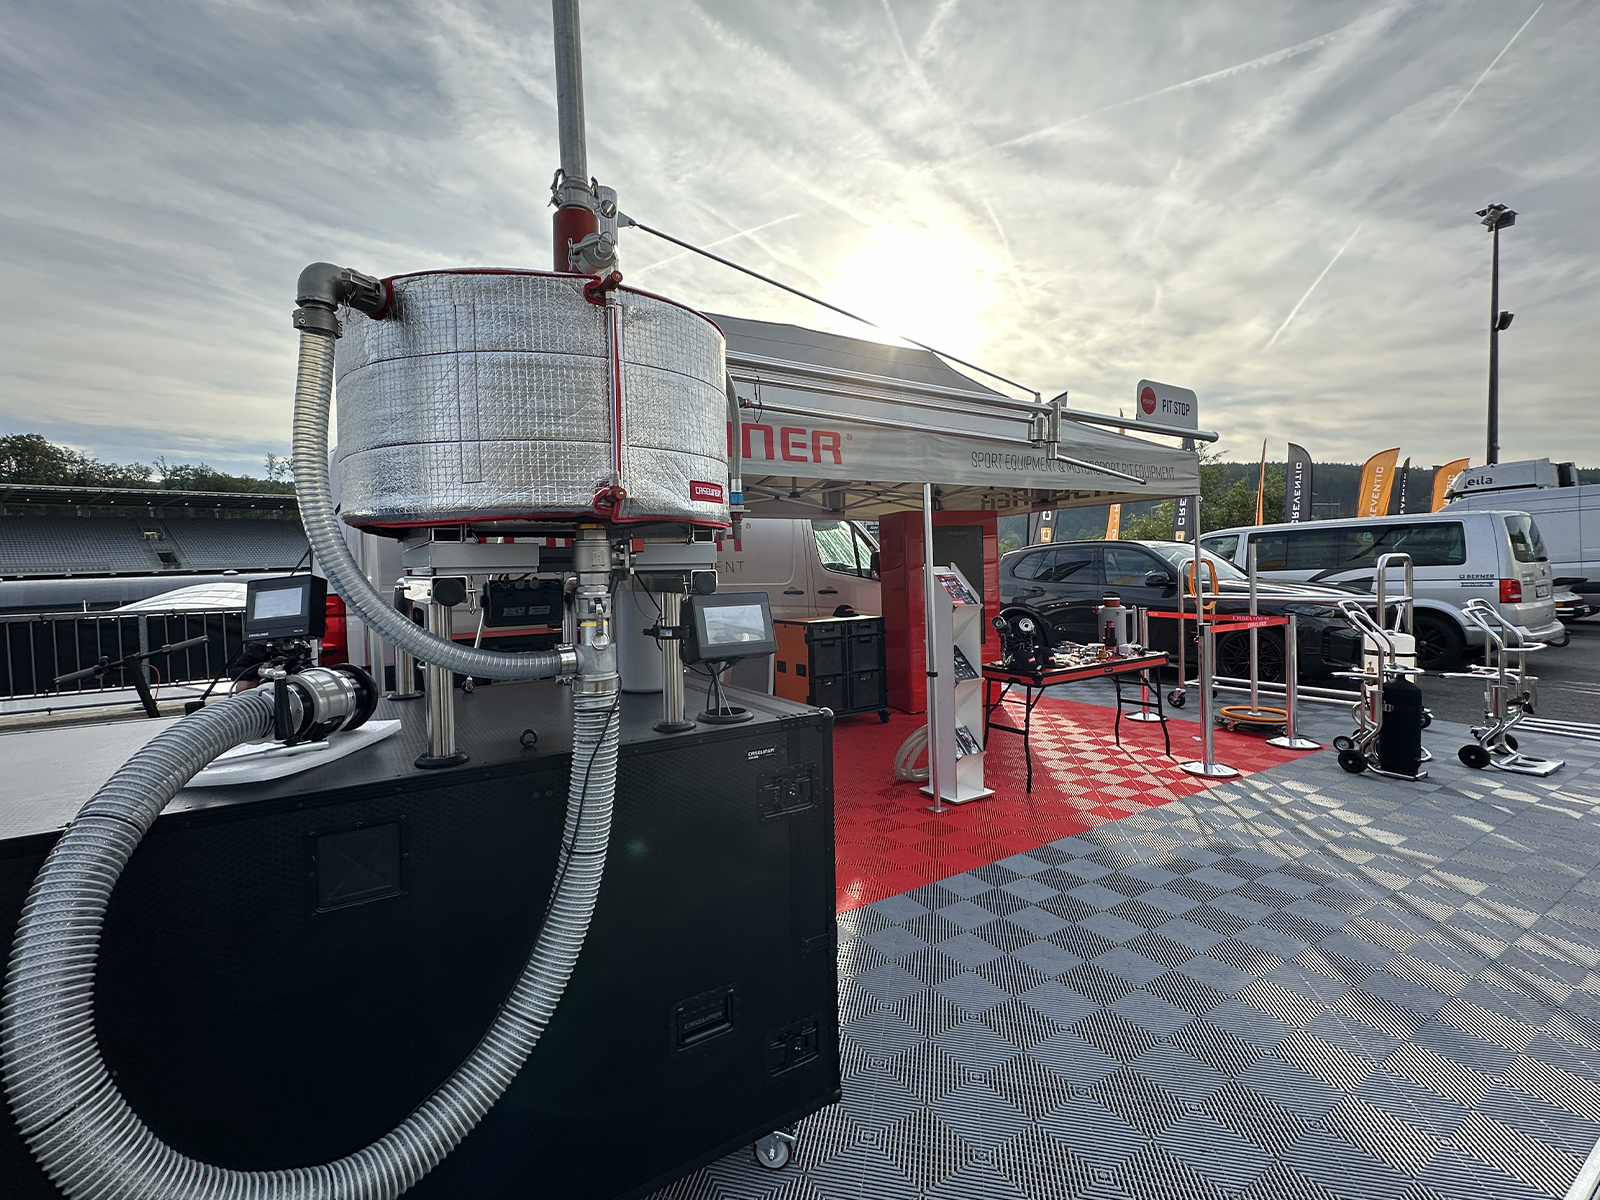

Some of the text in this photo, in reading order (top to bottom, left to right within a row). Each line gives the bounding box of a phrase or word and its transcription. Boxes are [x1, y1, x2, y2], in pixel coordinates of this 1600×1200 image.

[1162, 399, 1173, 414] PIT
[1173, 401, 1190, 416] STOP
[971, 451, 1003, 469] SPORT
[1005, 454, 1056, 473] EQUIPMENT
[1135, 464, 1175, 480] EQUIPMENT
[1368, 466, 1384, 518] REVENTIC
